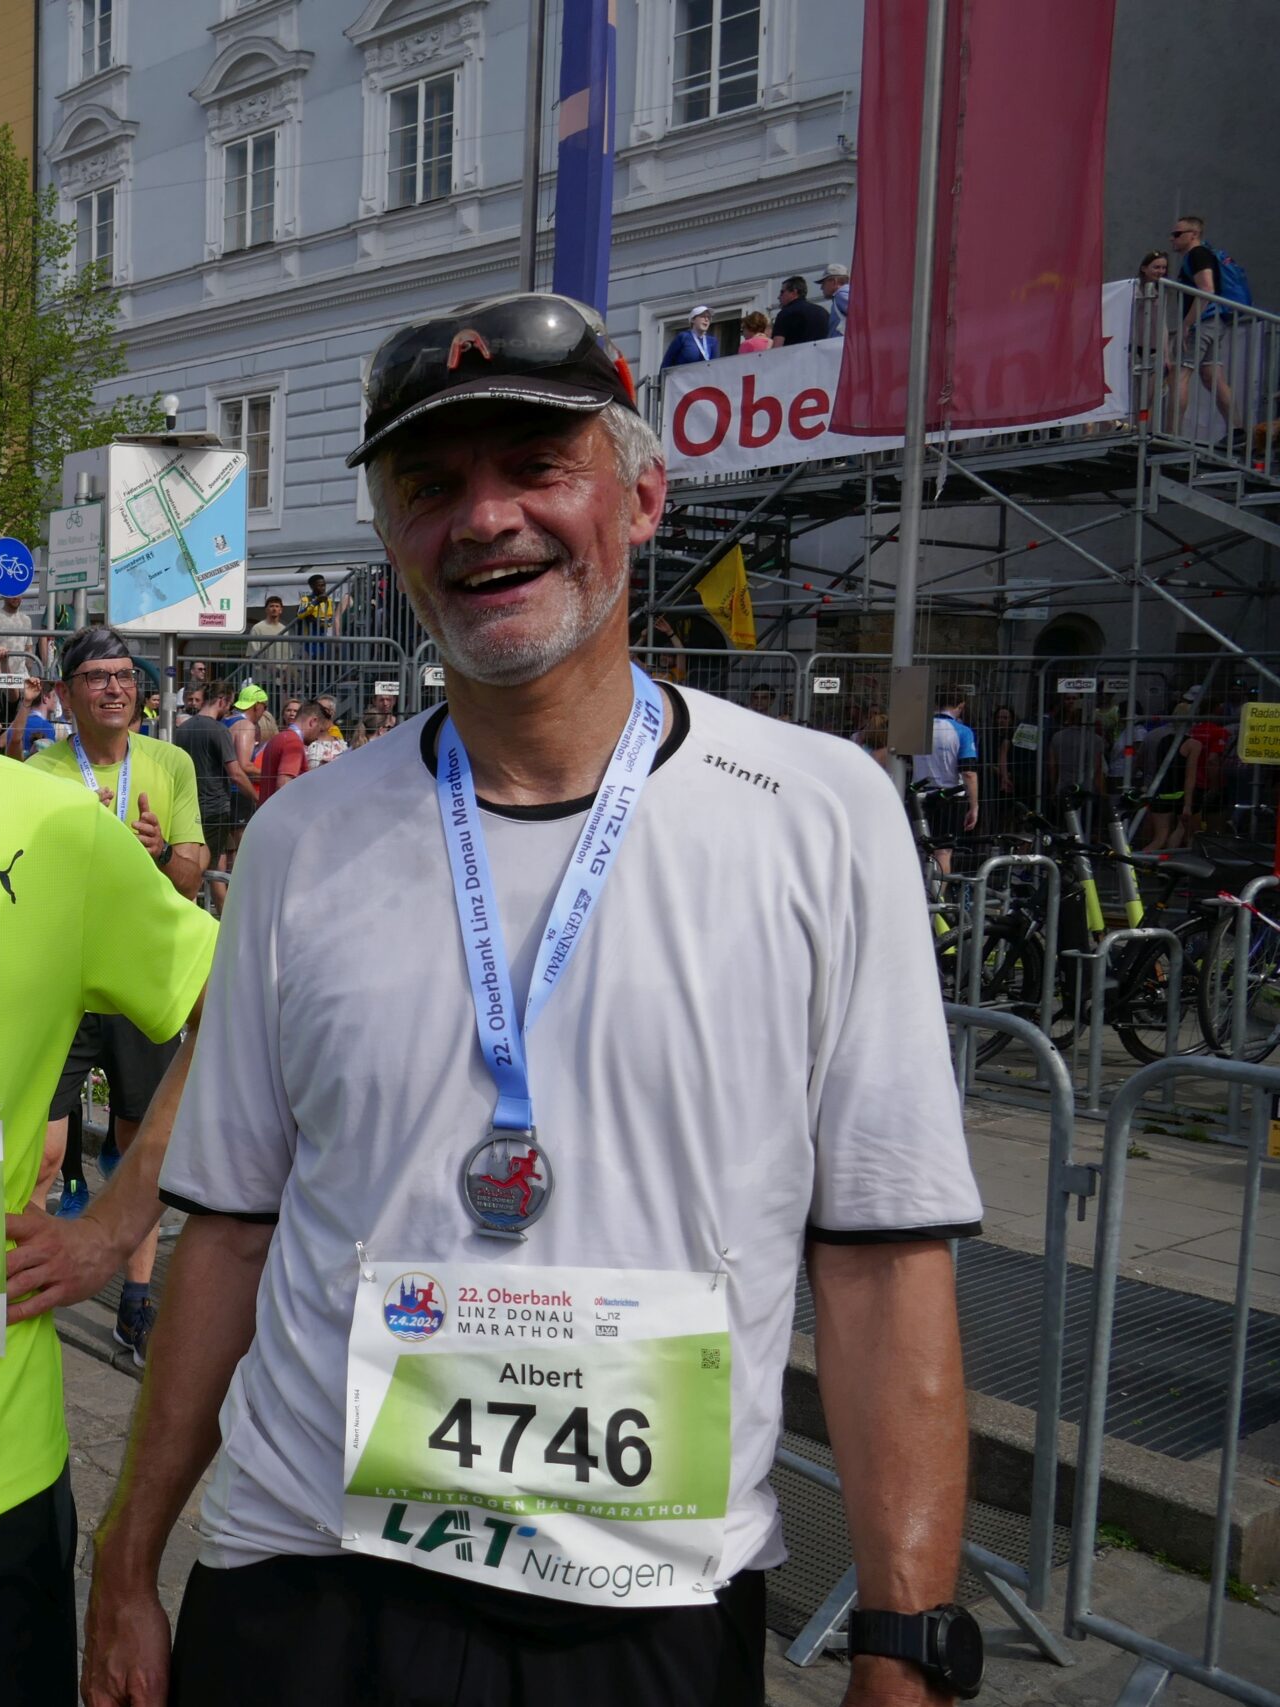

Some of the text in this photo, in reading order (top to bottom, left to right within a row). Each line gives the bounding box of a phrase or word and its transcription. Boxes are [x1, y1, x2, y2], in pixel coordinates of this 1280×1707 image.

[145, 551, 155, 561] R1
[614, 698, 643, 761] Halbmarathon
[624, 699, 660, 773] LAT Nitrogen
[703, 754, 780, 795] skinfit
[575, 784, 616, 865] Viertelmarathon
[589, 785, 636, 877] LINZ AG
[446, 747, 513, 1068] 22. Oberbank Linz Donau Marathon
[544, 910, 584, 984] GENERALI
[458, 1287, 573, 1307] 22. Oberbank
[458, 1306, 574, 1323] LINZ DONAU
[389, 1314, 439, 1328] 7.4.2024
[458, 1321, 574, 1339] MARATHON
[499, 1363, 584, 1389] Albert
[353, 1428, 361, 1449] Albert
[428, 1398, 653, 1487] 4746
[375, 1486, 698, 1517] LAT NITROGEN HALBMARATHON
[381, 1502, 674, 1598] LAT Nitrogen
